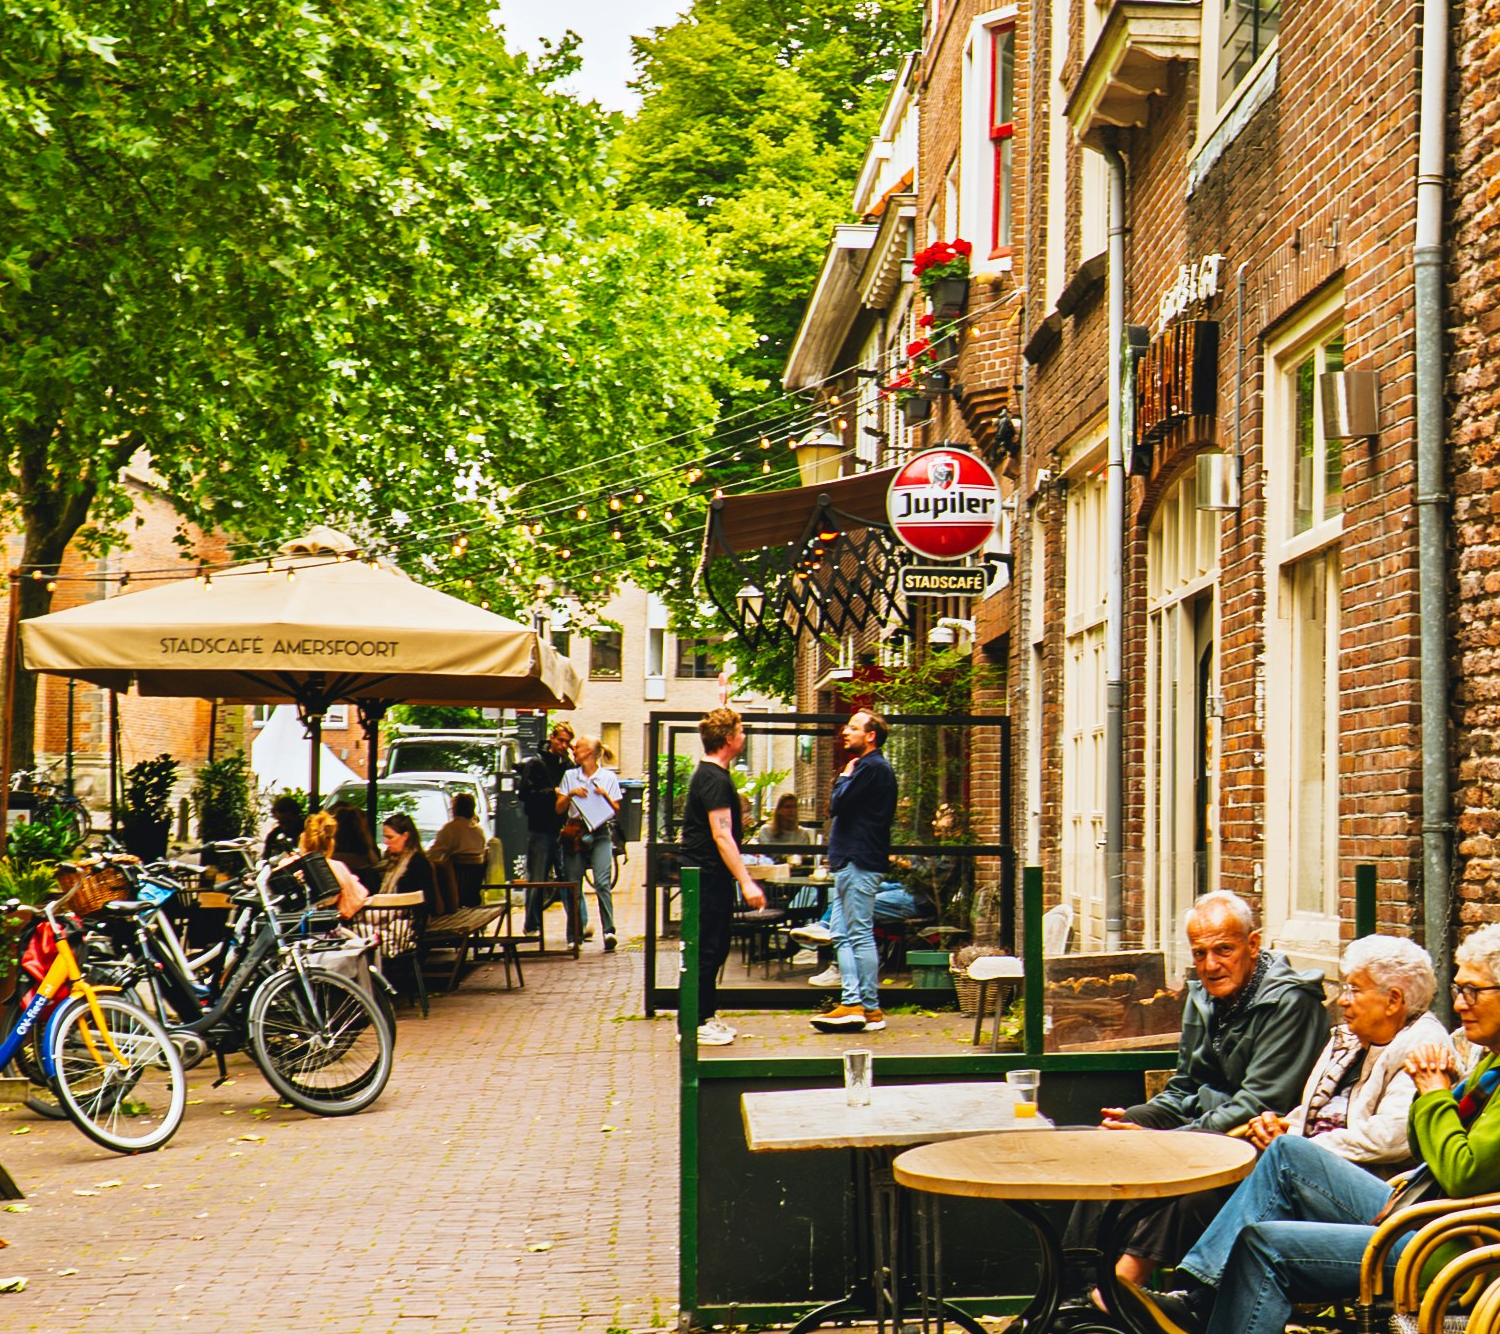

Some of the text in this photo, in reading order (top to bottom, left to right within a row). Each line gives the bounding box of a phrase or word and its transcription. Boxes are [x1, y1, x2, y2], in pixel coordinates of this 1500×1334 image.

[896, 491, 995, 520] Jupiler
[904, 573, 982, 590] STADSCAFÉ
[159, 635, 400, 658] STADSCAFÉ AMERSFOORT
